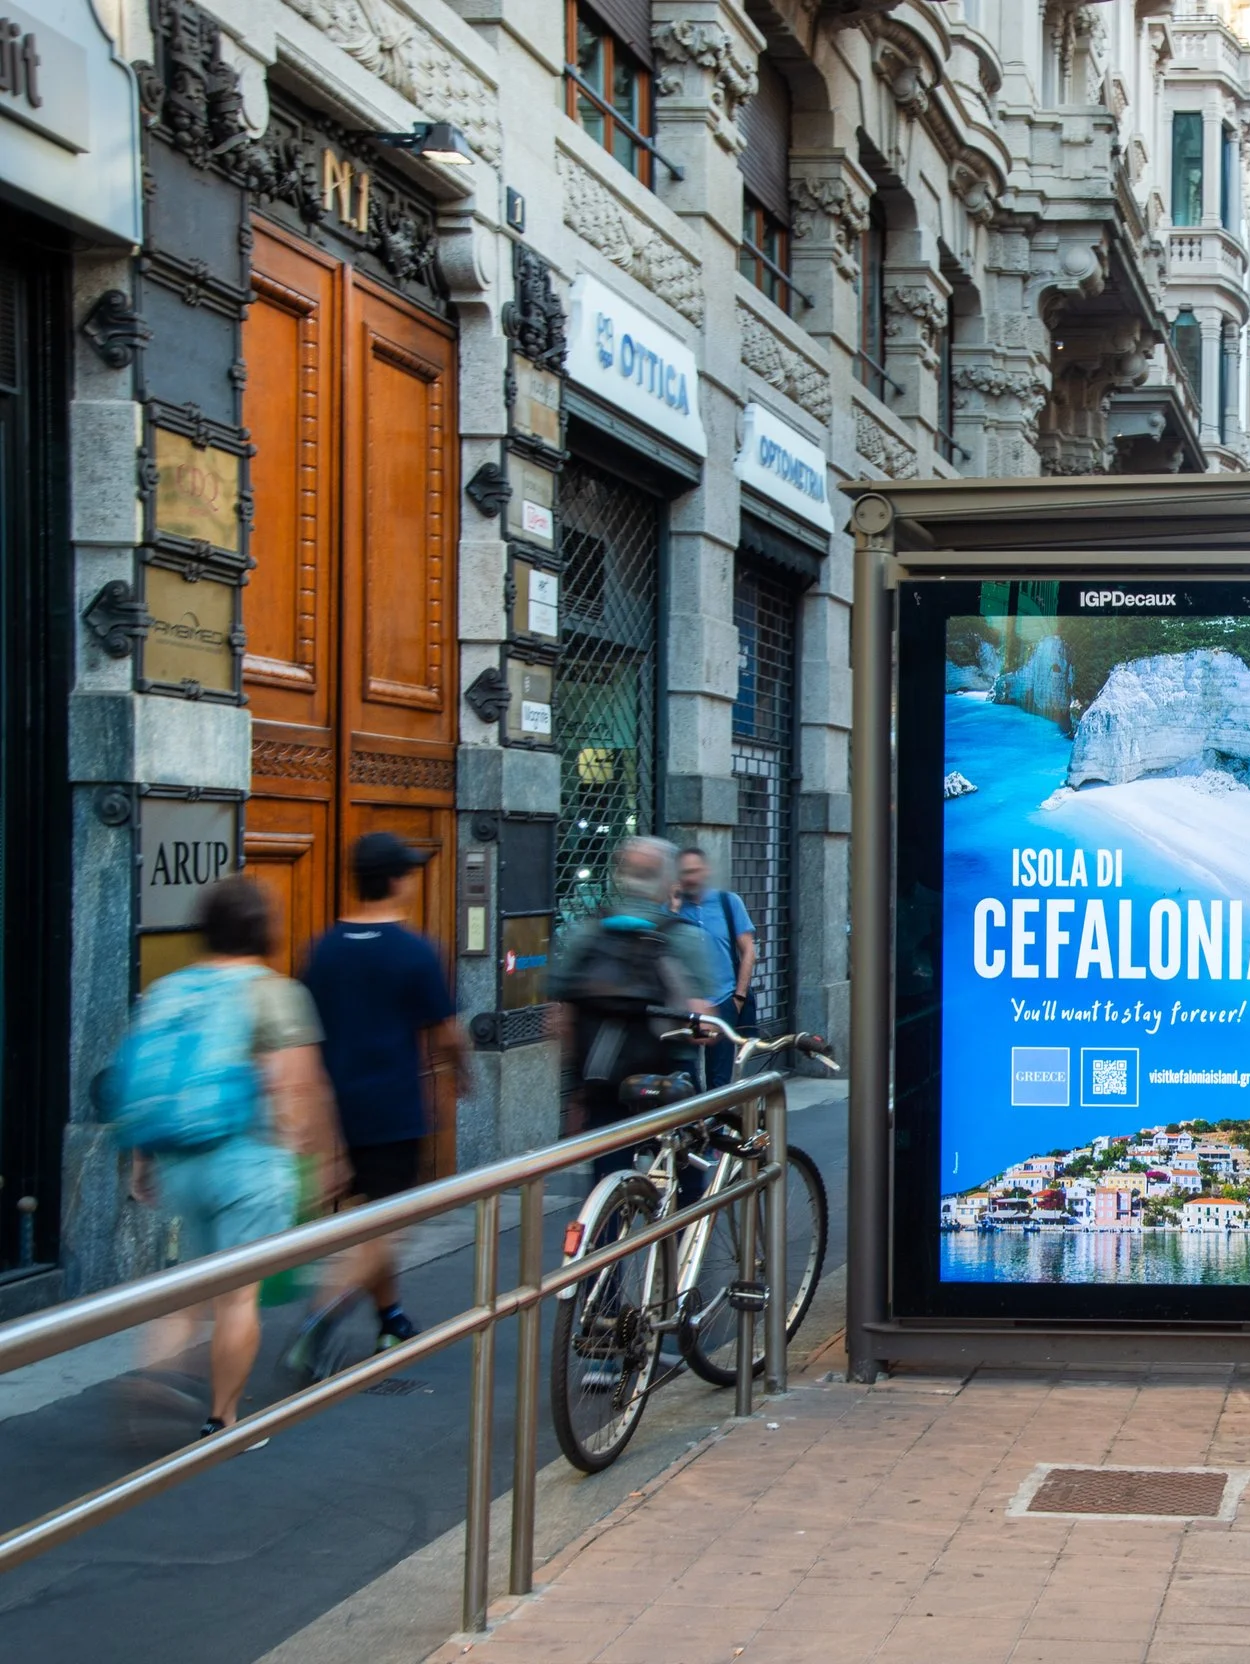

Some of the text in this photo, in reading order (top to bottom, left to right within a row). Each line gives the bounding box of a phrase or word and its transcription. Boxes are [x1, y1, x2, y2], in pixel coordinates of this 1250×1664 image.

[620, 333, 690, 416] OTTICA
[1080, 590, 1177, 607] IGPDecaux
[150, 841, 229, 885] ARUP
[1012, 848, 1123, 887] ISOLA DI
[1011, 998, 1247, 1035] You'll want to stay forever!
[1015, 1070, 1066, 1082] GREECE
[1149, 1069, 1250, 1088] visitkefaloniaisland.gr
